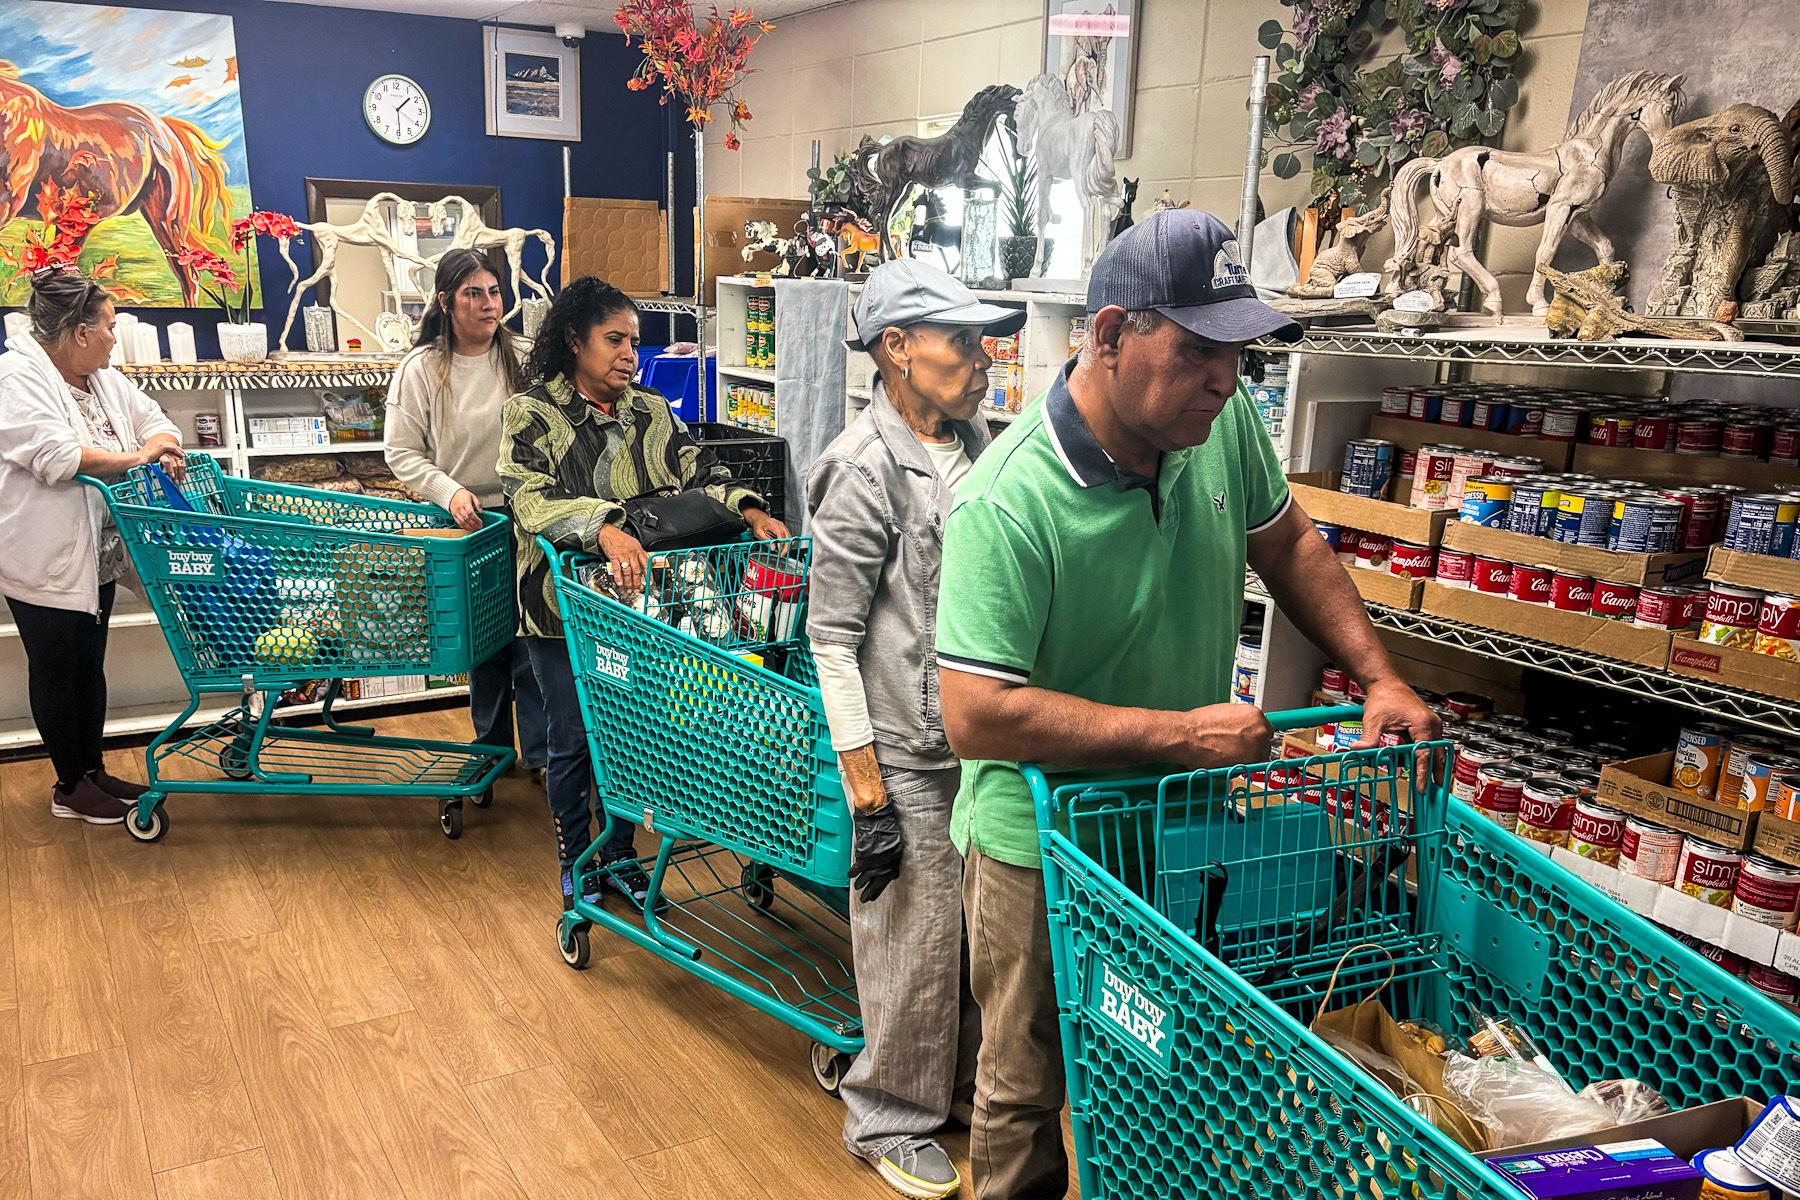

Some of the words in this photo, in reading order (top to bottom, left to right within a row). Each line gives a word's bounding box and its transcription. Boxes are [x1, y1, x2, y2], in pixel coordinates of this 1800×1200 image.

[168, 562, 215, 576] BABY
[596, 656, 630, 682] BABY
[1100, 987, 1166, 1056] BABY
